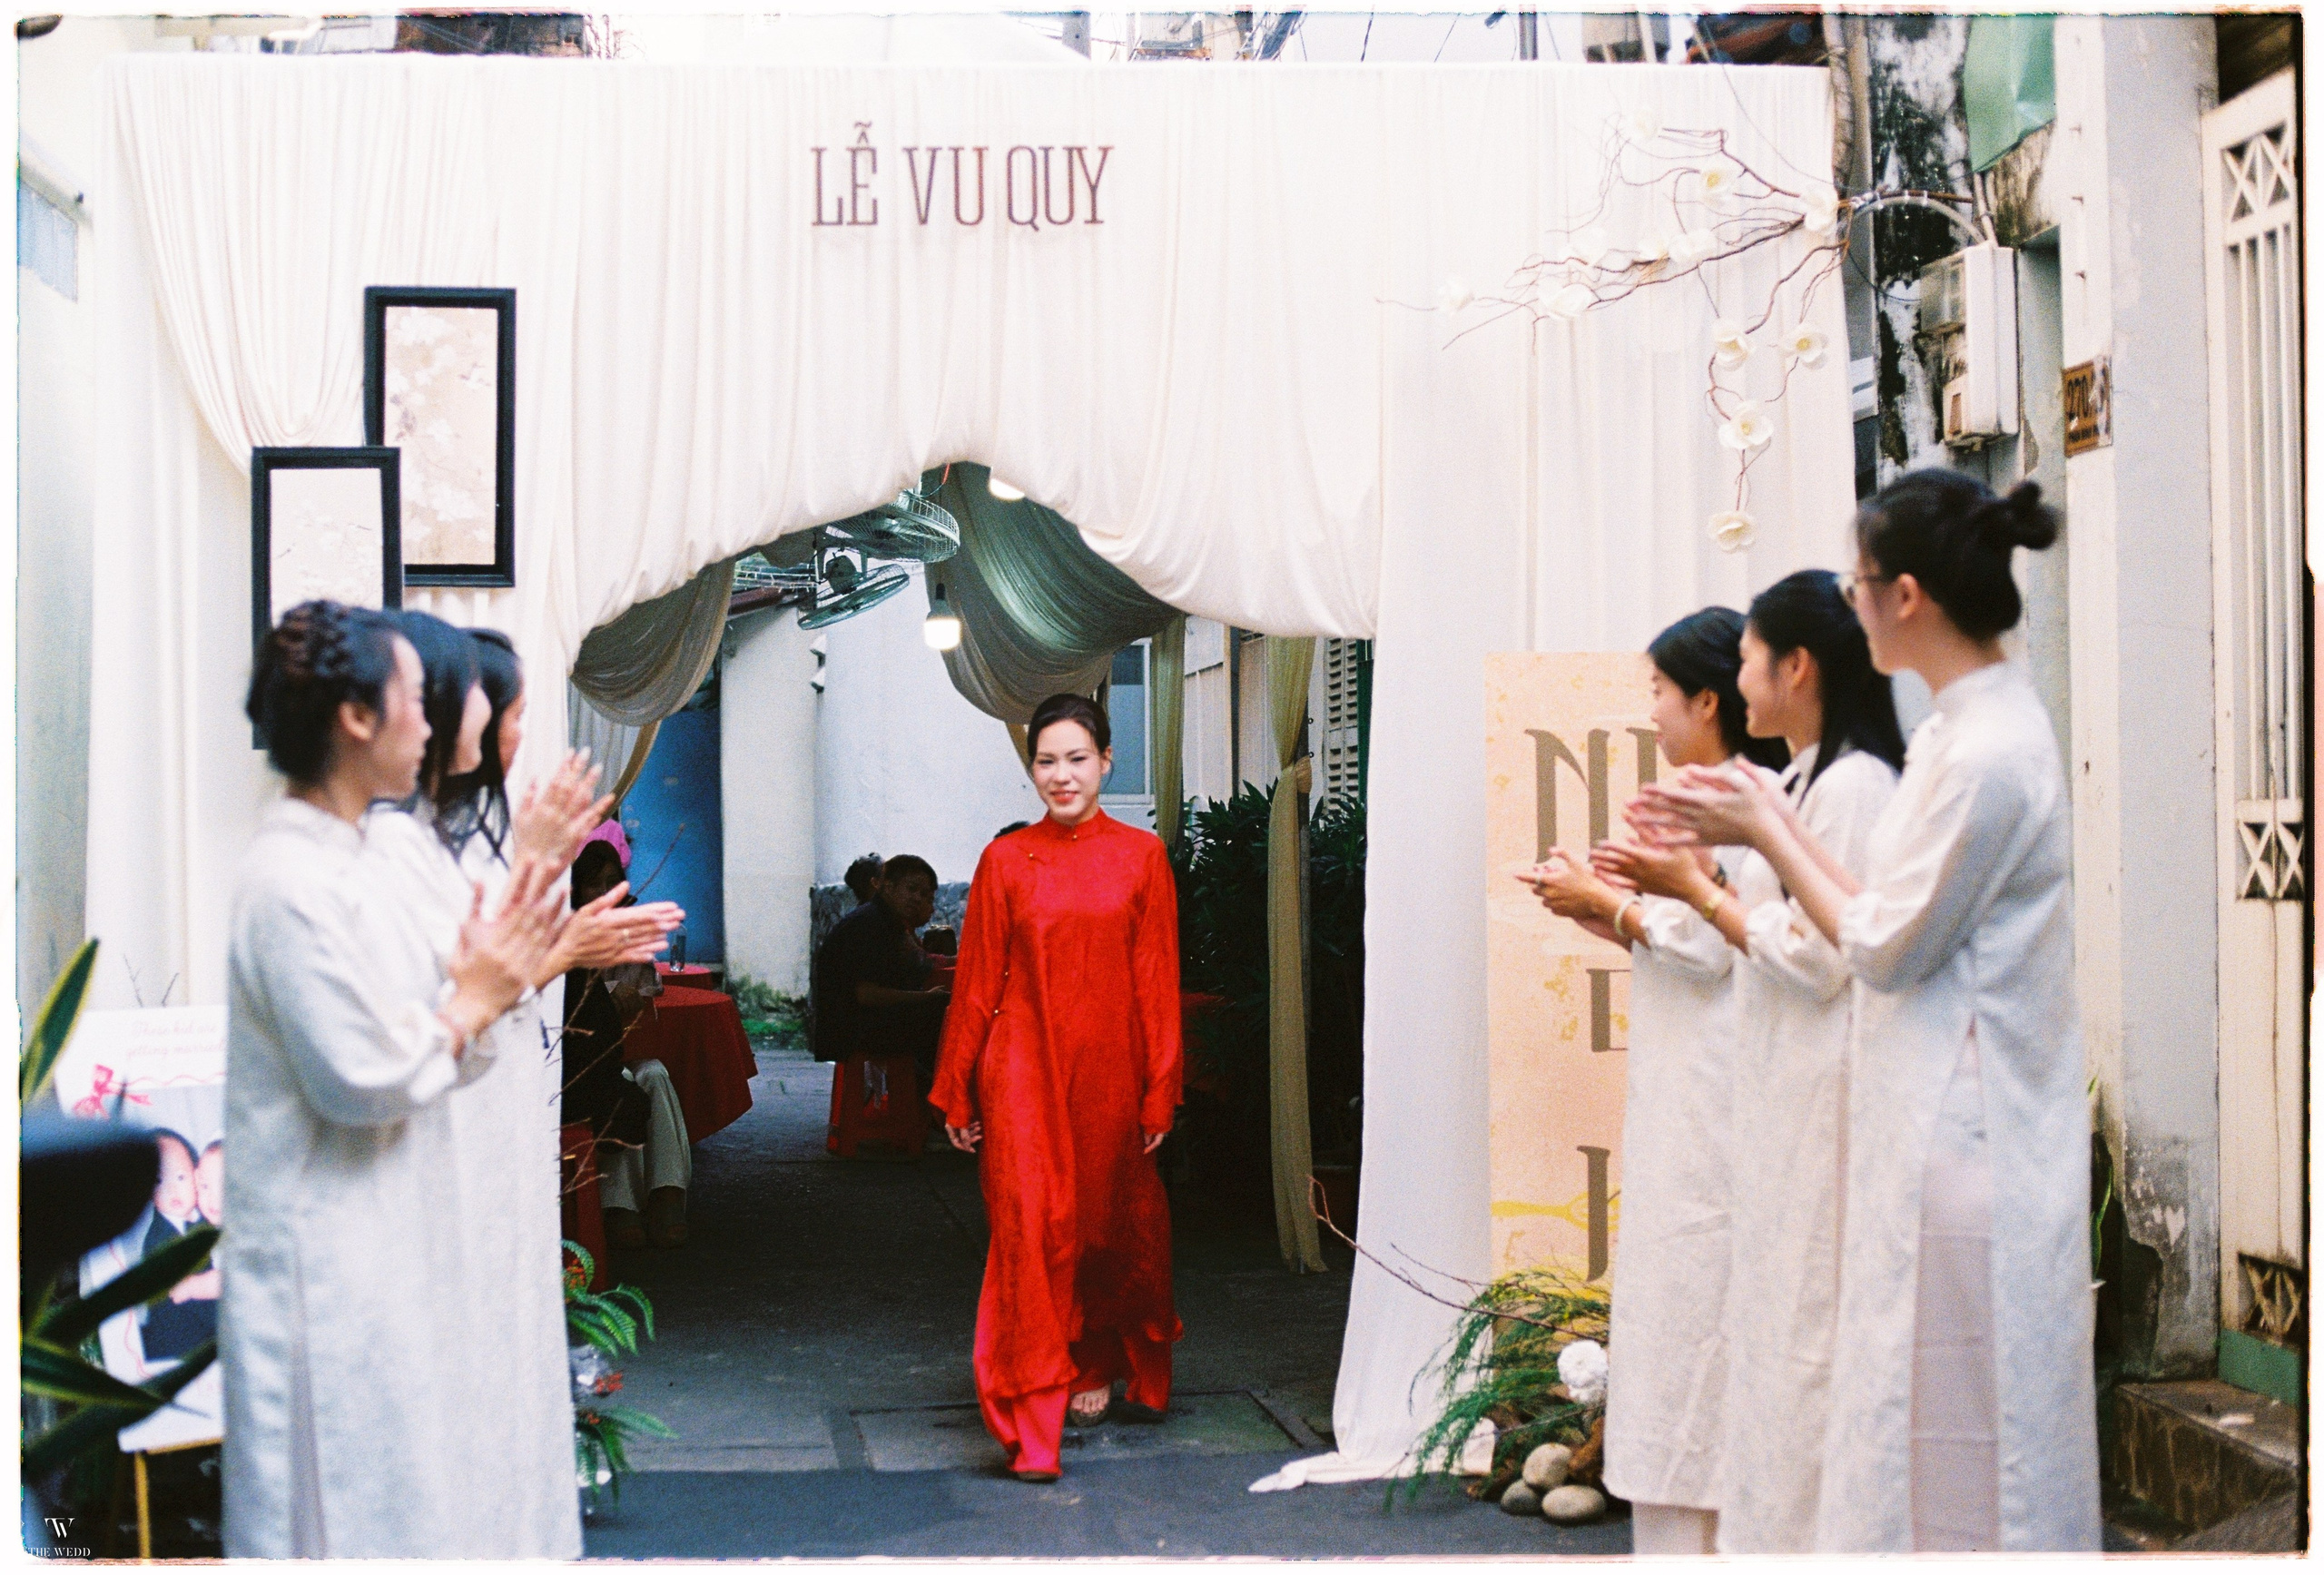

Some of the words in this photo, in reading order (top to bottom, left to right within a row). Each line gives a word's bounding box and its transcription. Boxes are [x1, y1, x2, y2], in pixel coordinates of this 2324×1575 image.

[811, 121, 878, 226] LỄ
[902, 145, 990, 226] VU
[1006, 144, 1115, 231] QUY
